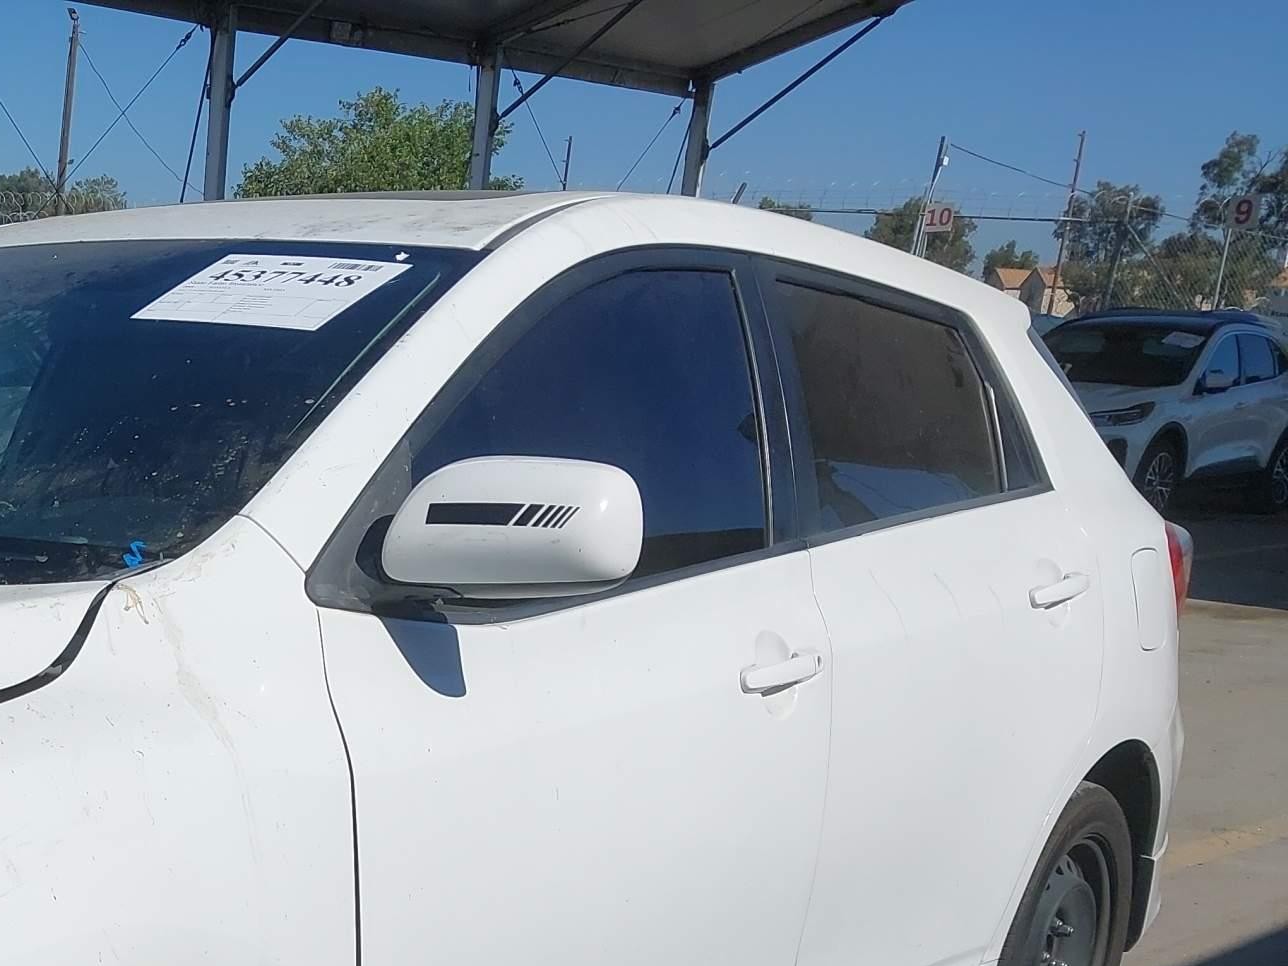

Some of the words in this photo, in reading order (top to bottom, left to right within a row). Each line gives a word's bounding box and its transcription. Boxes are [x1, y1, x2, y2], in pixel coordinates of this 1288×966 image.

[926, 208, 952, 226] 10
[1235, 199, 1253, 225] 9
[208, 269, 362, 288] 45377448
